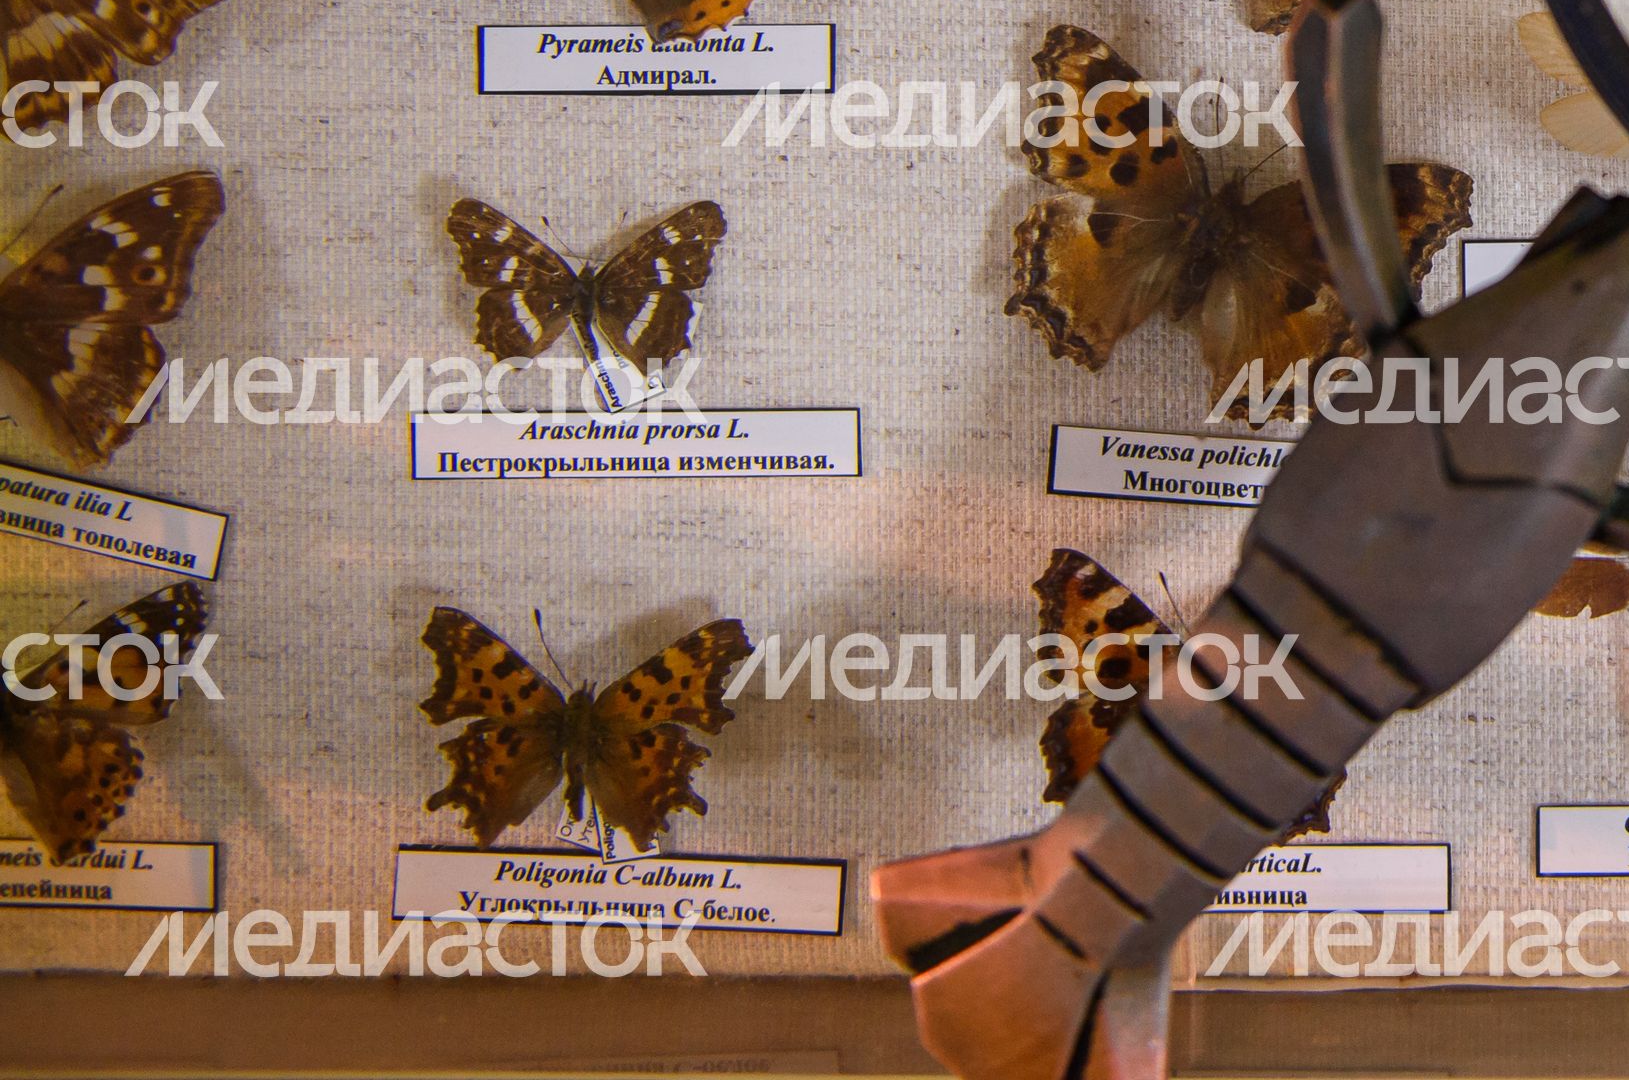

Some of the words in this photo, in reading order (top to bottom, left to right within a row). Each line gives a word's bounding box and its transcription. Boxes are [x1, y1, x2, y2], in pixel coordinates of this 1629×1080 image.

[537, 32, 644, 58] Pyrameis
[752, 32, 774, 53] L.
[598, 63, 716, 90] Адмирал.
[519, 418, 639, 442] Araschnia
[645, 422, 722, 446] prorsa
[727, 417, 750, 440] L.
[437, 452, 671, 479] Пестрокрыльница
[677, 453, 834, 475] изменчивая.
[1100, 435, 1195, 462] Vanessa
[1200, 442, 1288, 470] polichl
[74, 490, 114, 519] ilia
[115, 498, 134, 521] L
[71, 526, 197, 564] тополевая
[133, 847, 153, 869] L.
[495, 860, 606, 891] Poligonia
[614, 863, 714, 889] C-album
[720, 865, 742, 890] L.
[674, 897, 776, 923] С-белое.
